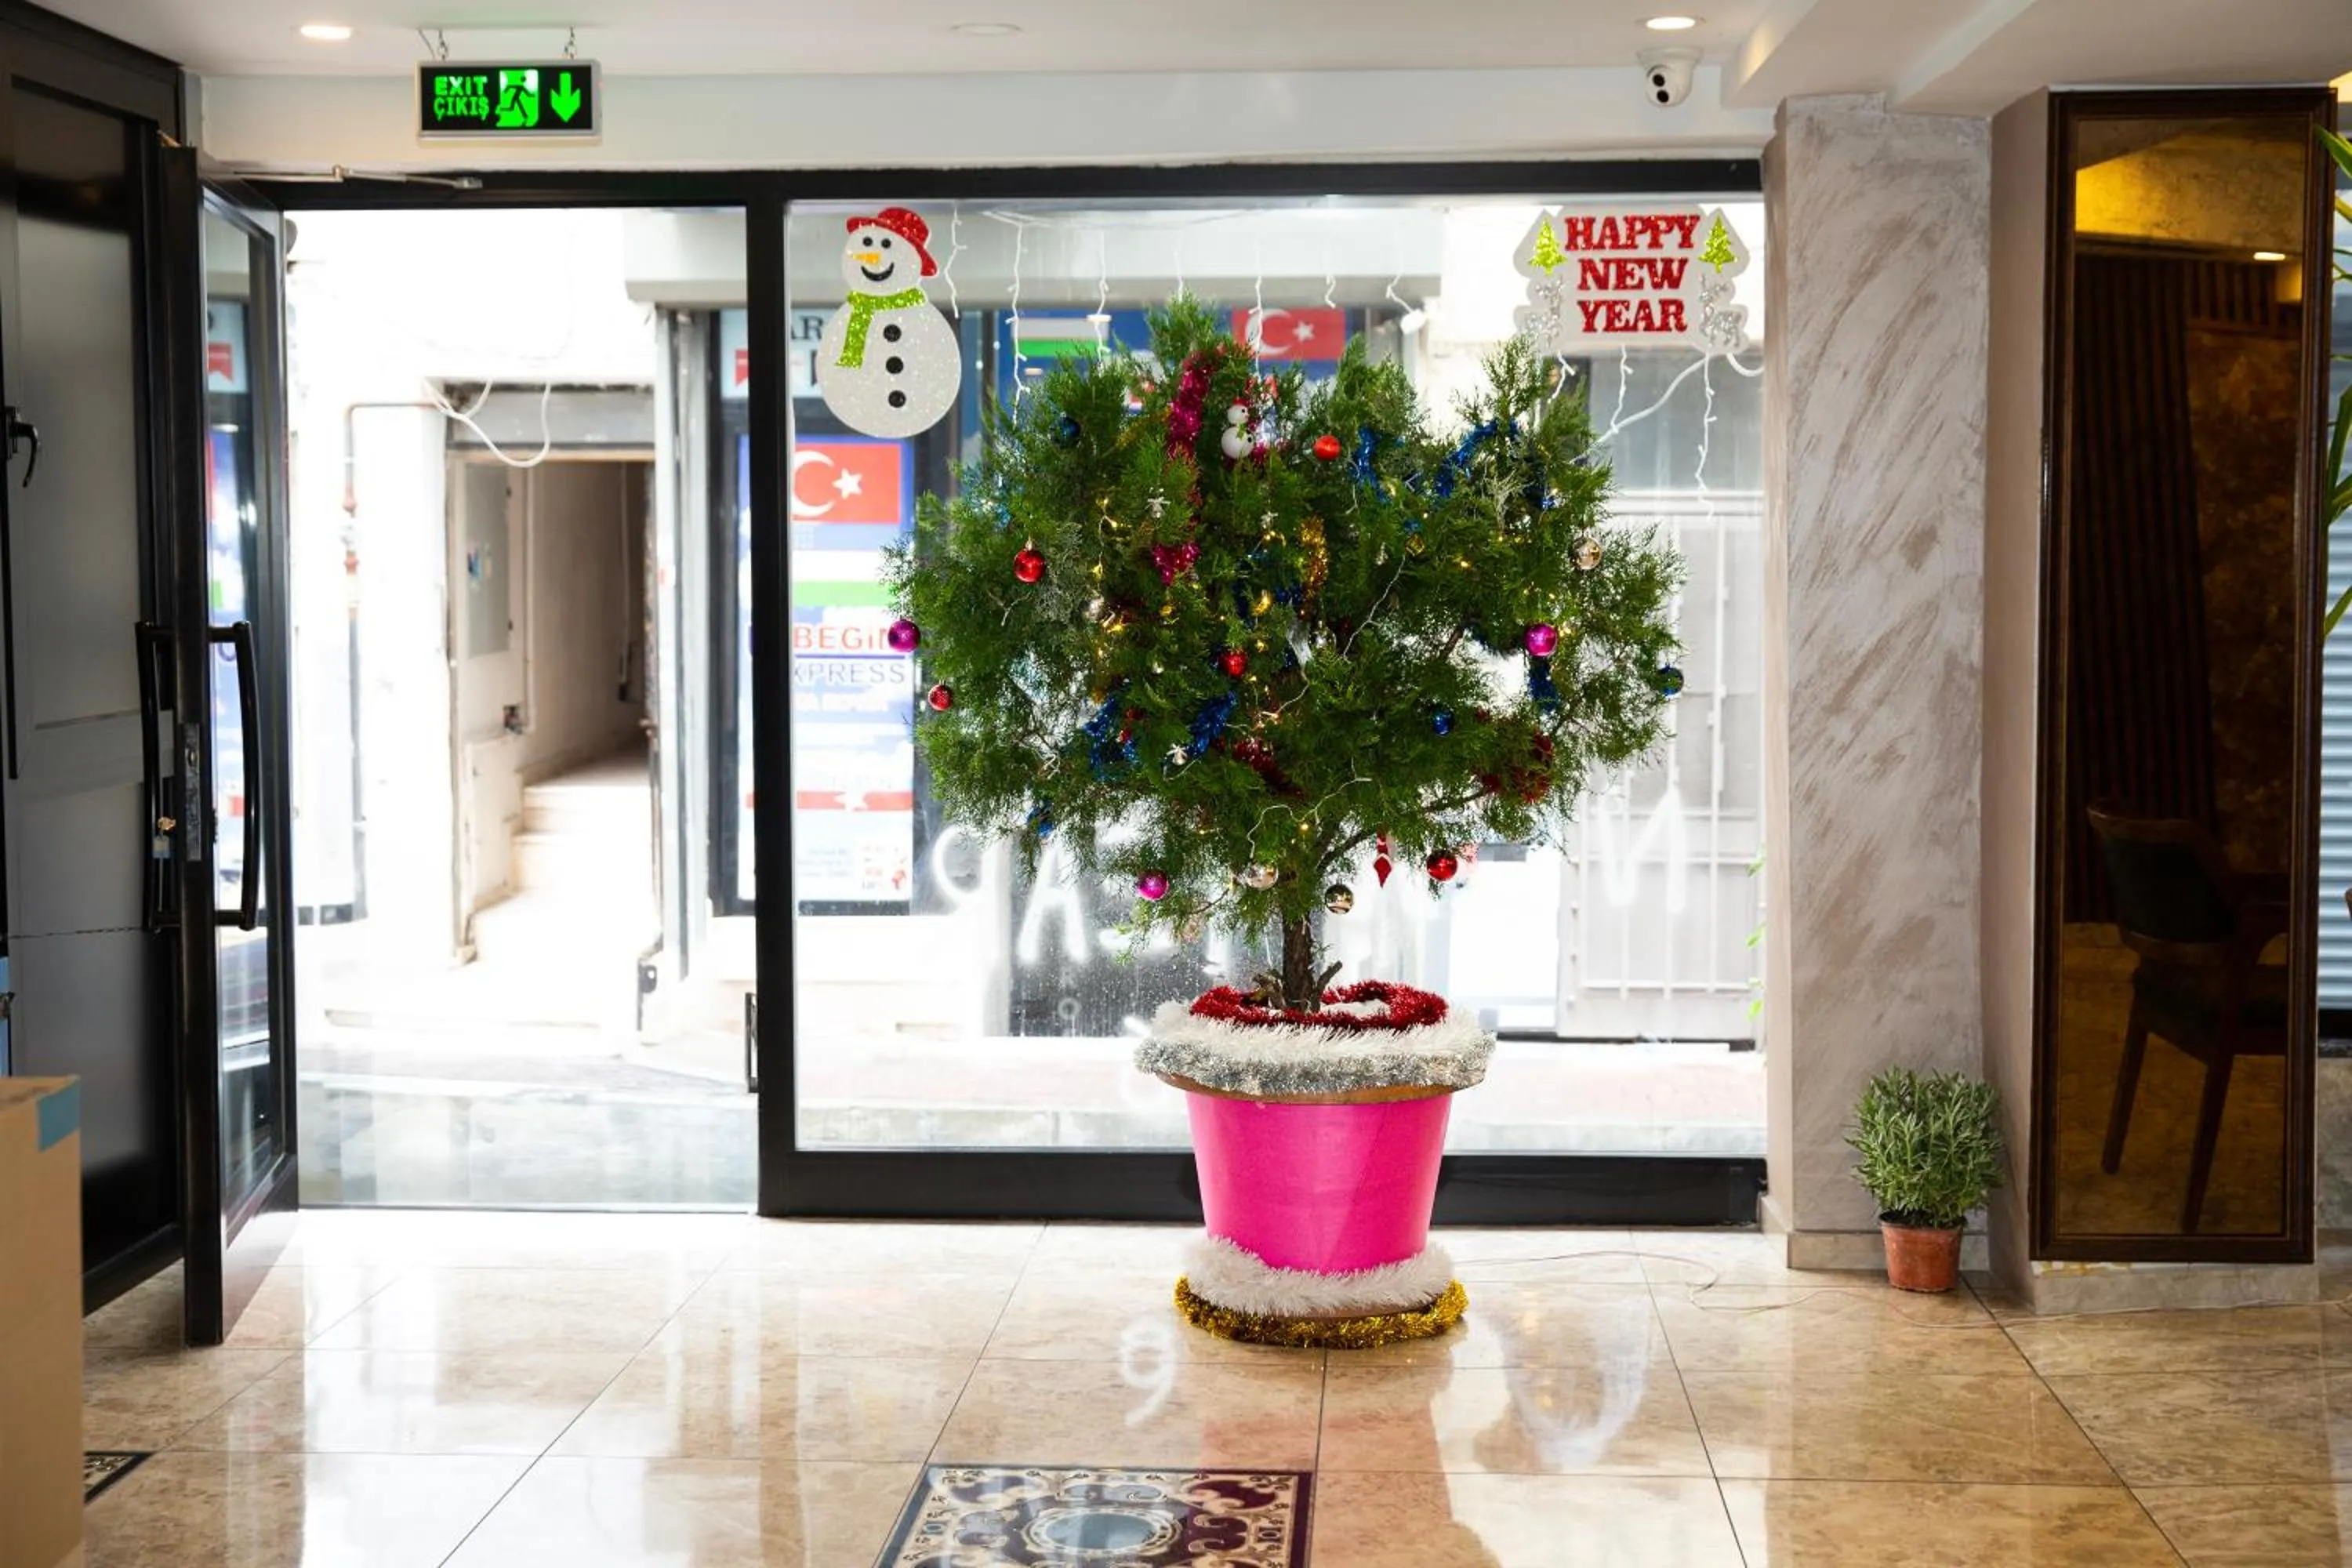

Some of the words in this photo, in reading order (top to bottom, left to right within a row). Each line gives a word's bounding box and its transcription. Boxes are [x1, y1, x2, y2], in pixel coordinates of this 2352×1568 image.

[434, 75, 488, 96] EXIT
[1564, 214, 1700, 252] HAPPY
[1577, 257, 1689, 291] NEW
[1577, 298, 1688, 333] YEAR
